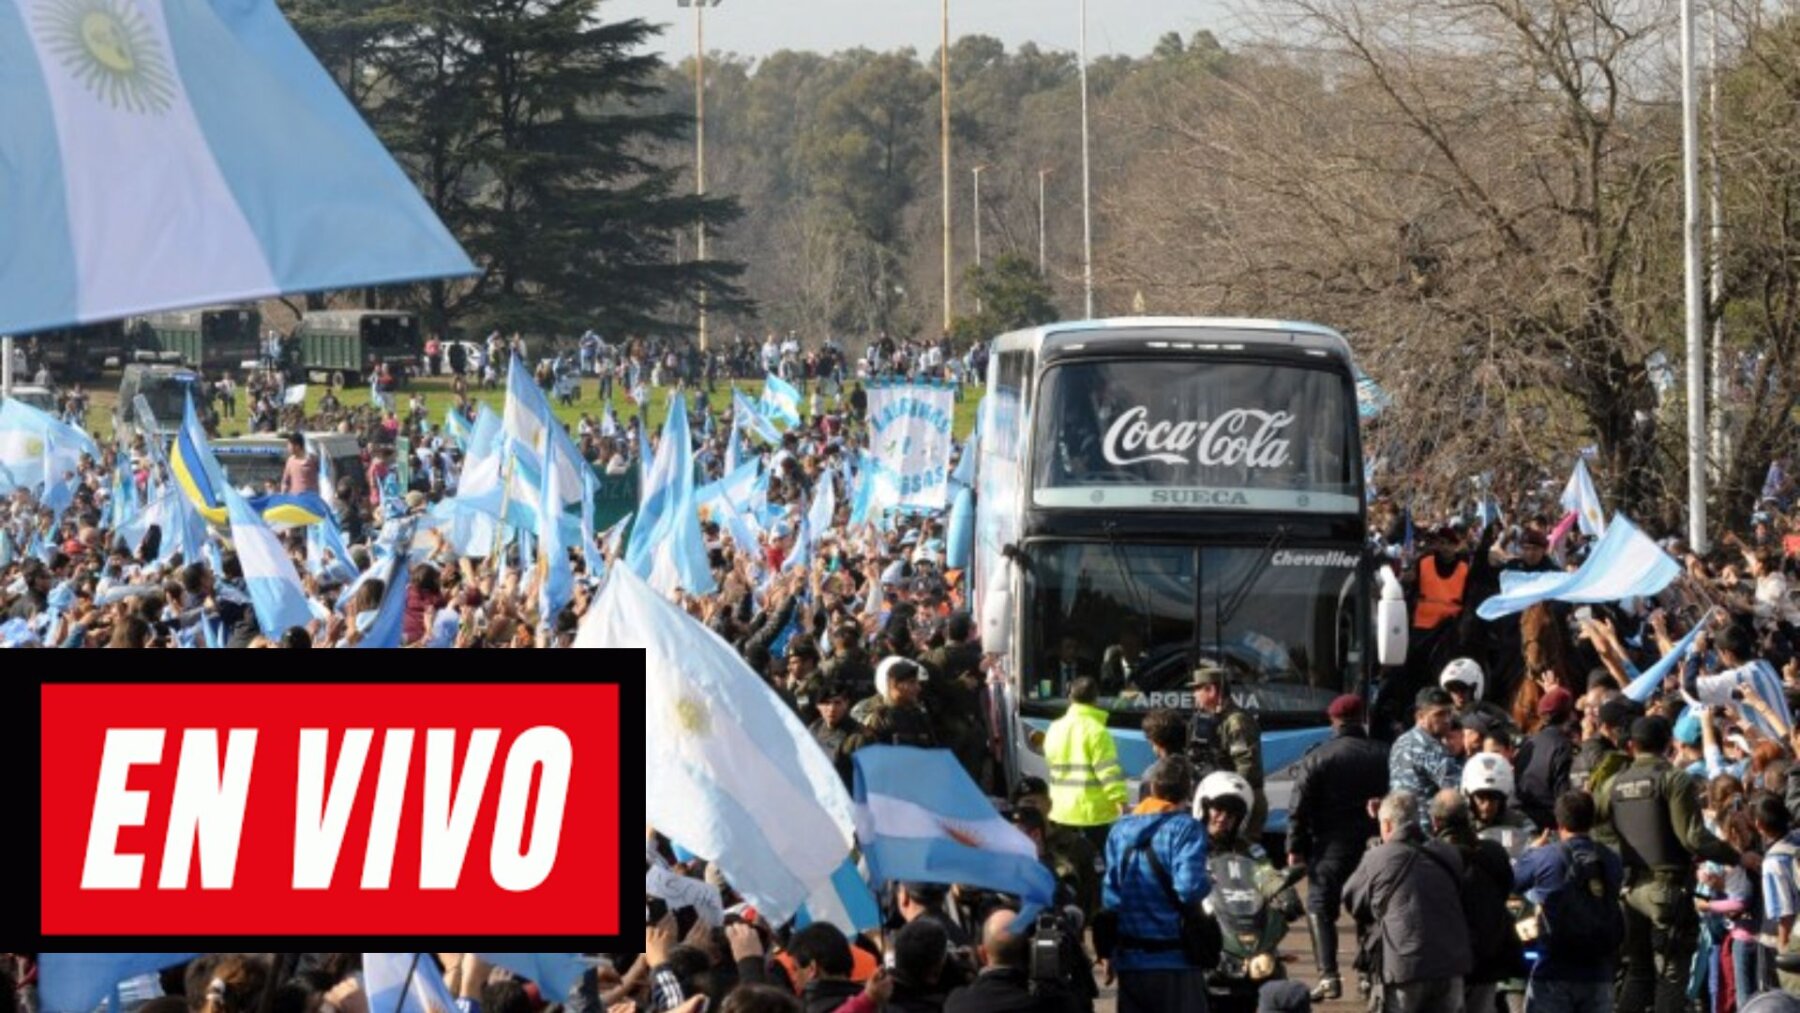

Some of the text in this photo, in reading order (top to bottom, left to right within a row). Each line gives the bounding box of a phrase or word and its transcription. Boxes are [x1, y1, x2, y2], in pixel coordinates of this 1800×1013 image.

[1103, 405, 1295, 468] Coca-Cola
[1151, 489, 1249, 505] SUECA
[1271, 549, 1361, 569] Chevallier
[1134, 691, 1260, 709] ARGENA
